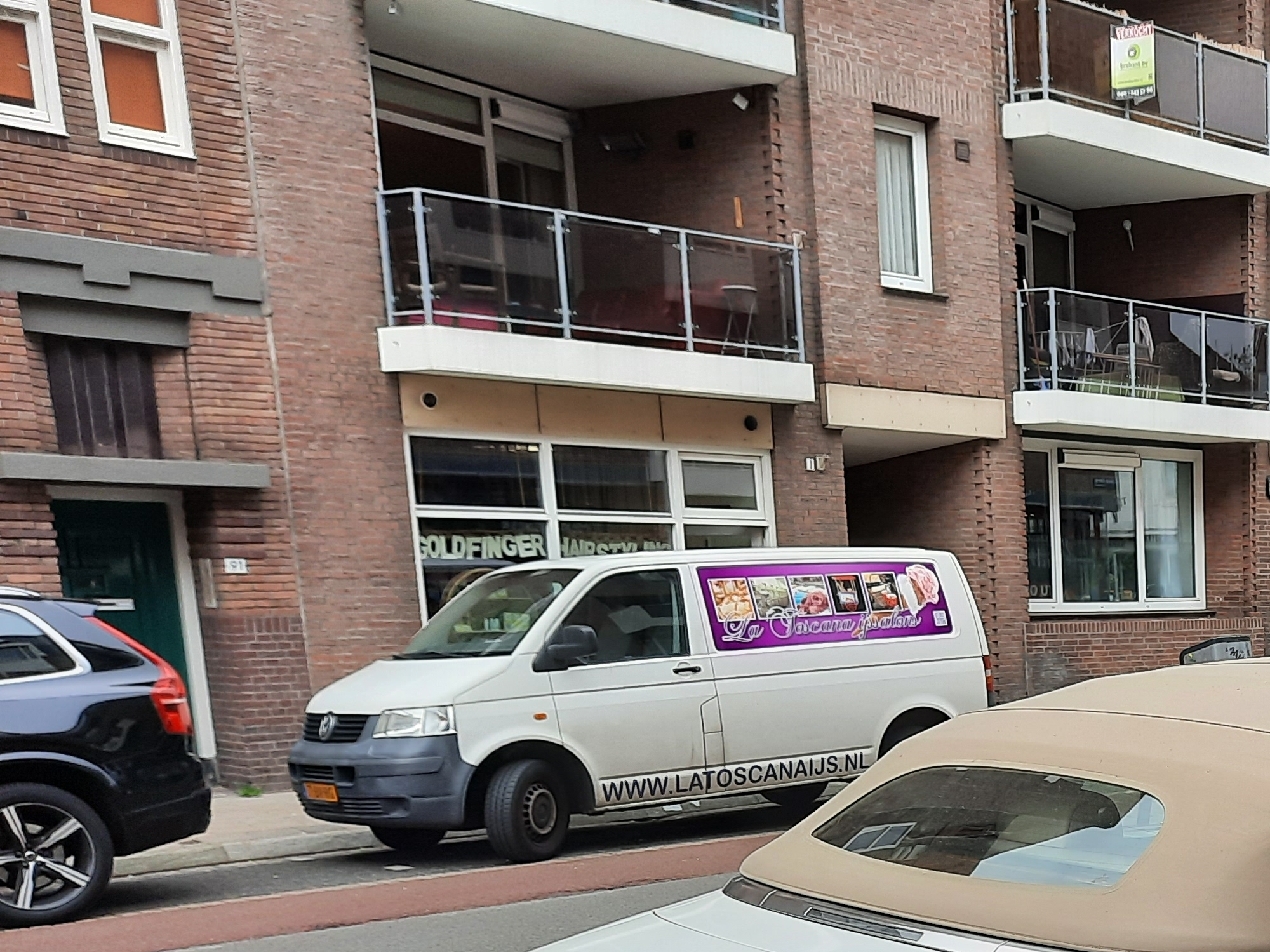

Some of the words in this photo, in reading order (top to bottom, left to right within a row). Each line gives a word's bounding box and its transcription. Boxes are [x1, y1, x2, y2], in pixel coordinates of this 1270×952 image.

[418, 534, 547, 560] GOLDFINGER
[722, 611, 764, 643] La
[766, 605, 857, 639] Toscana
[602, 751, 870, 802] WWW.LATOSCANAIJS.NL
